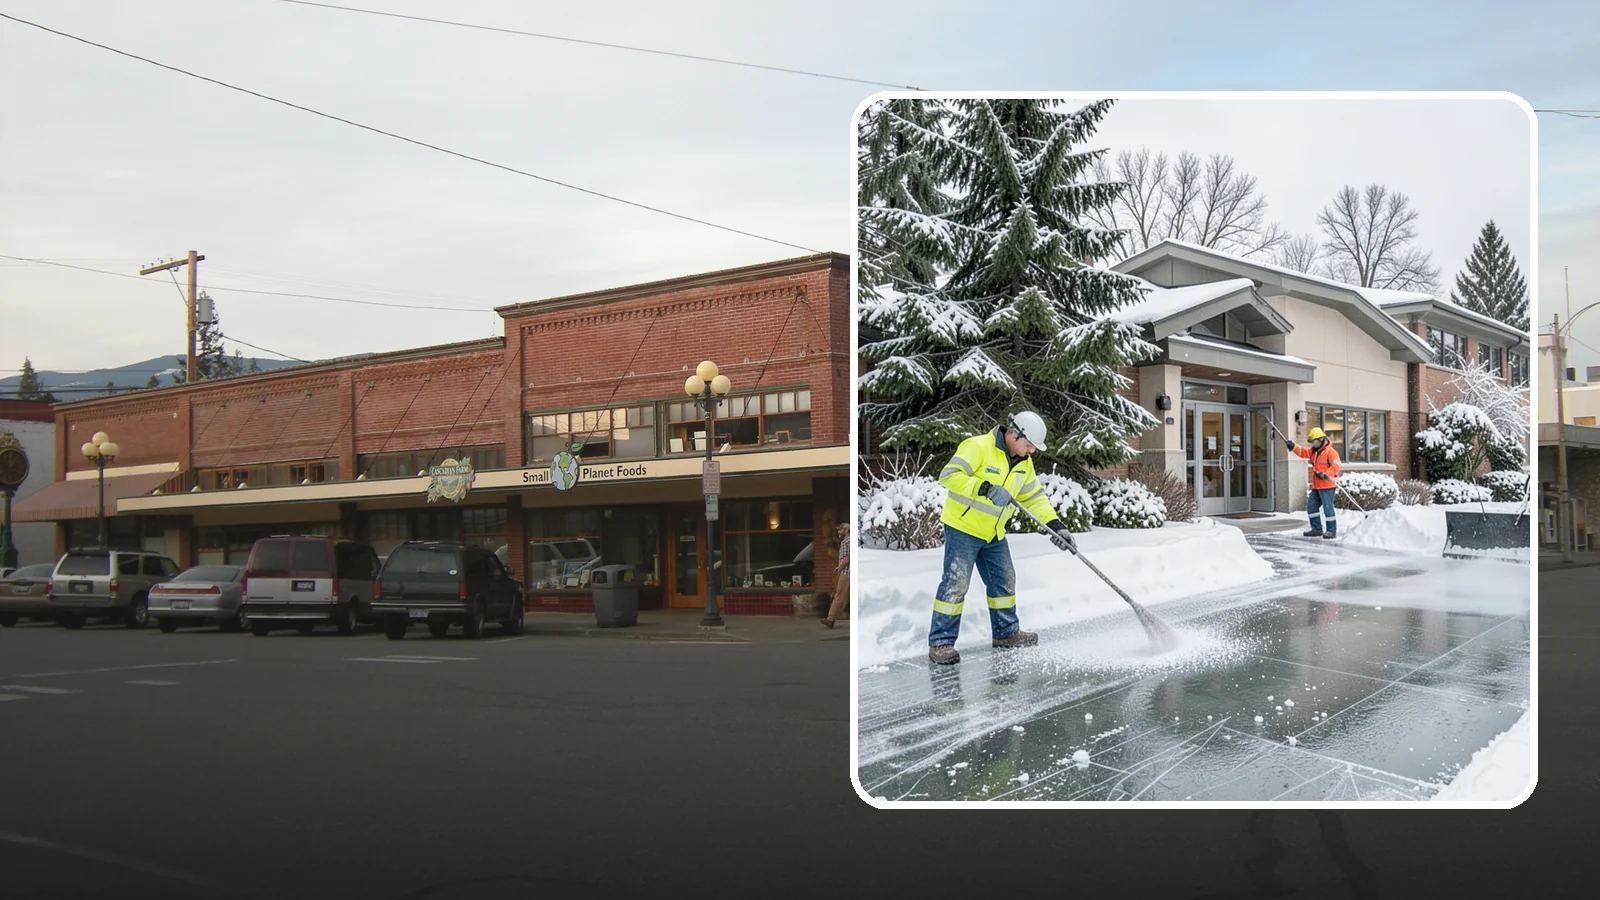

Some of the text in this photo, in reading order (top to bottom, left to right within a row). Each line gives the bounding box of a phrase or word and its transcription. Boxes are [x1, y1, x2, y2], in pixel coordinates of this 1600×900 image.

[523, 464, 647, 483] Small Planet Foods
